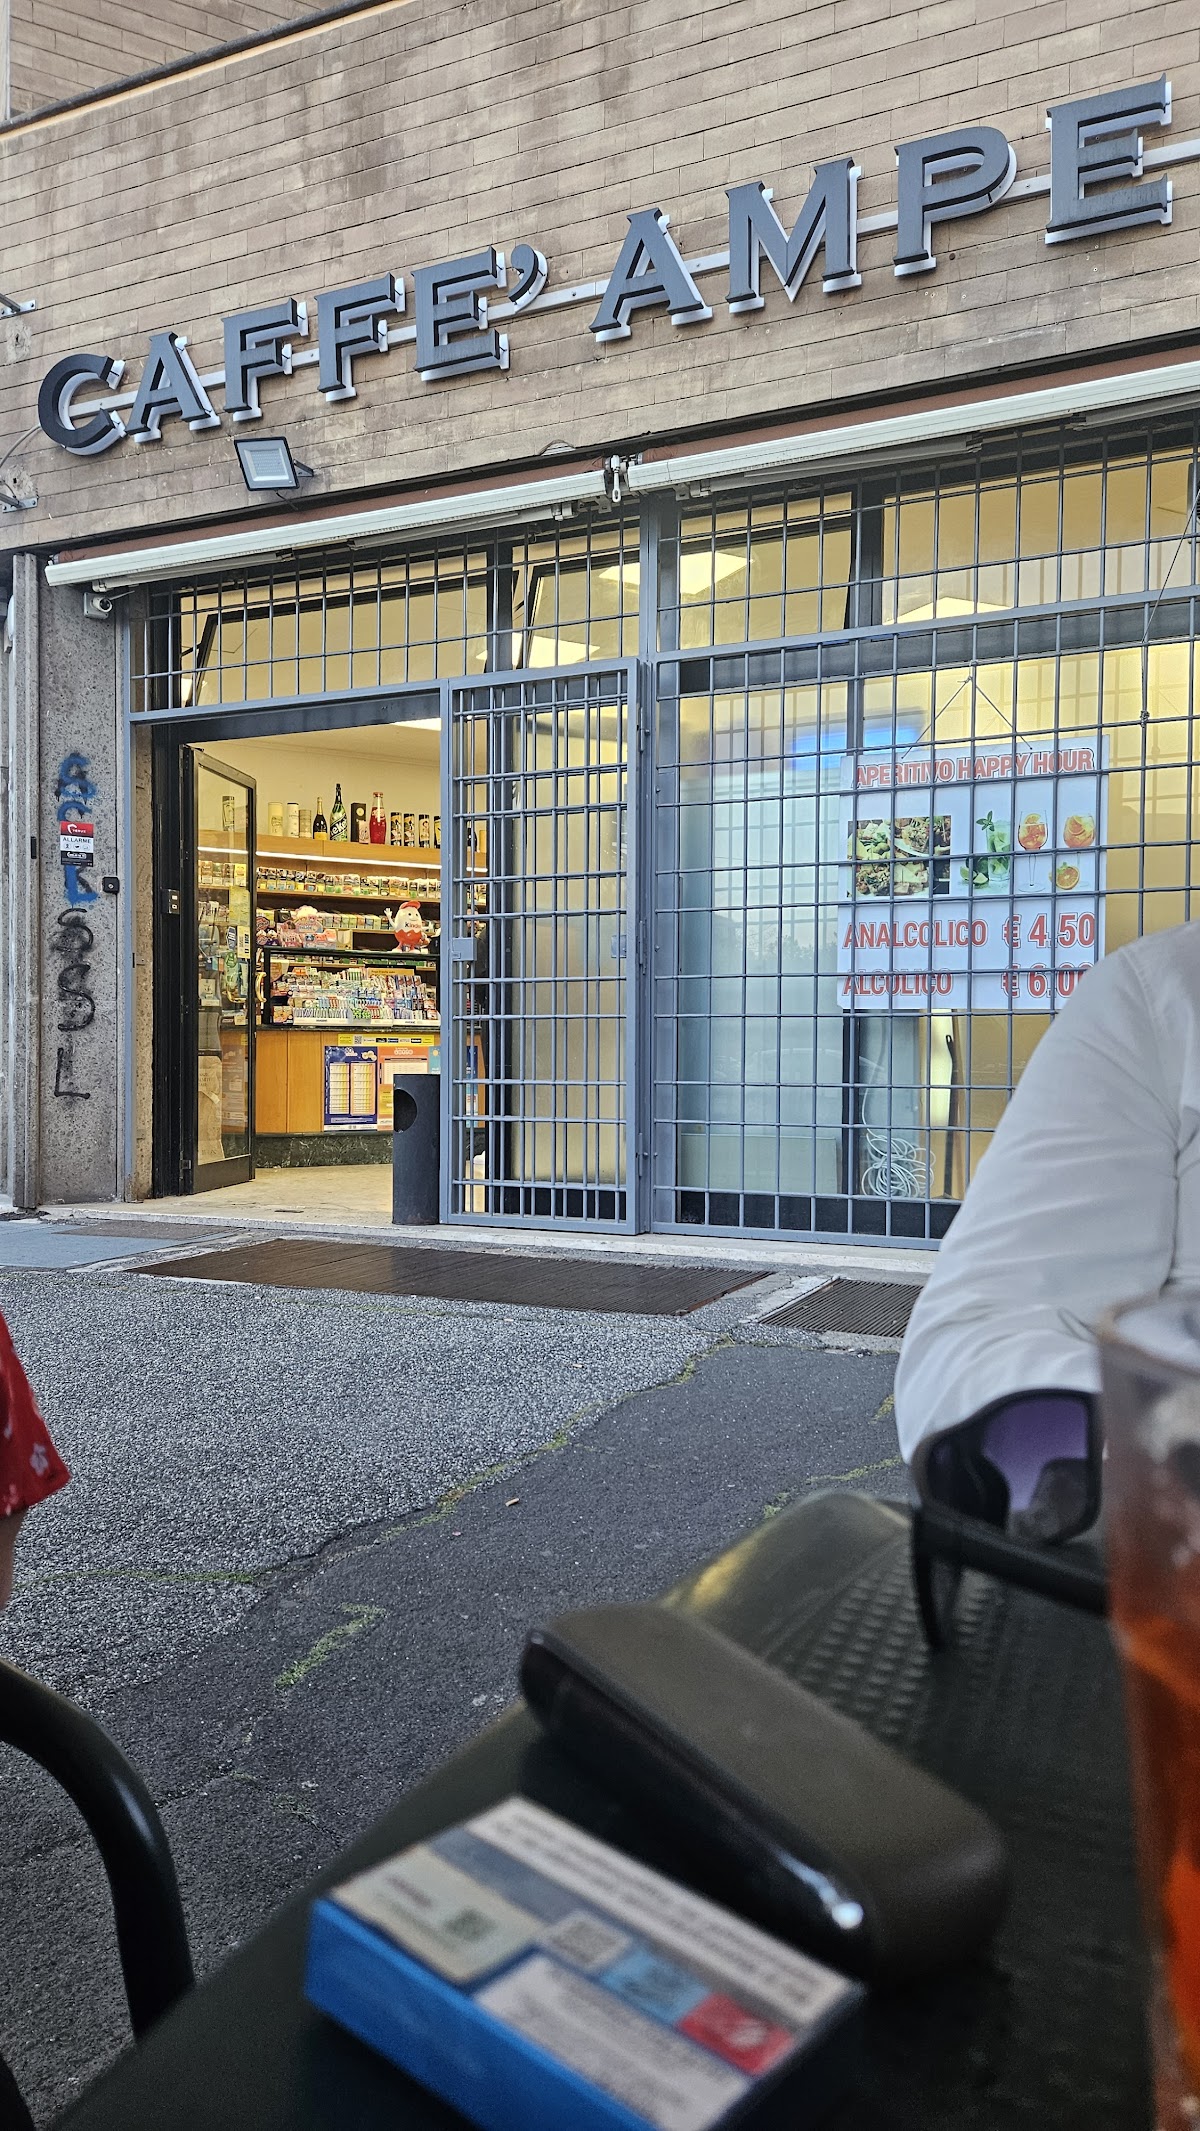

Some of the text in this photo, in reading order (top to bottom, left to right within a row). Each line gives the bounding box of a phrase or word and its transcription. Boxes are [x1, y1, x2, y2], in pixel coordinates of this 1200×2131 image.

[589, 73, 1171, 339] AMPE
[853, 748, 1094, 788] APERITIVO HAPPY HOUR
[842, 912, 1095, 949] ANALCOLICO € 4.50
[842, 968, 954, 996] ALCOLICO
[1001, 964, 1020, 998] €
